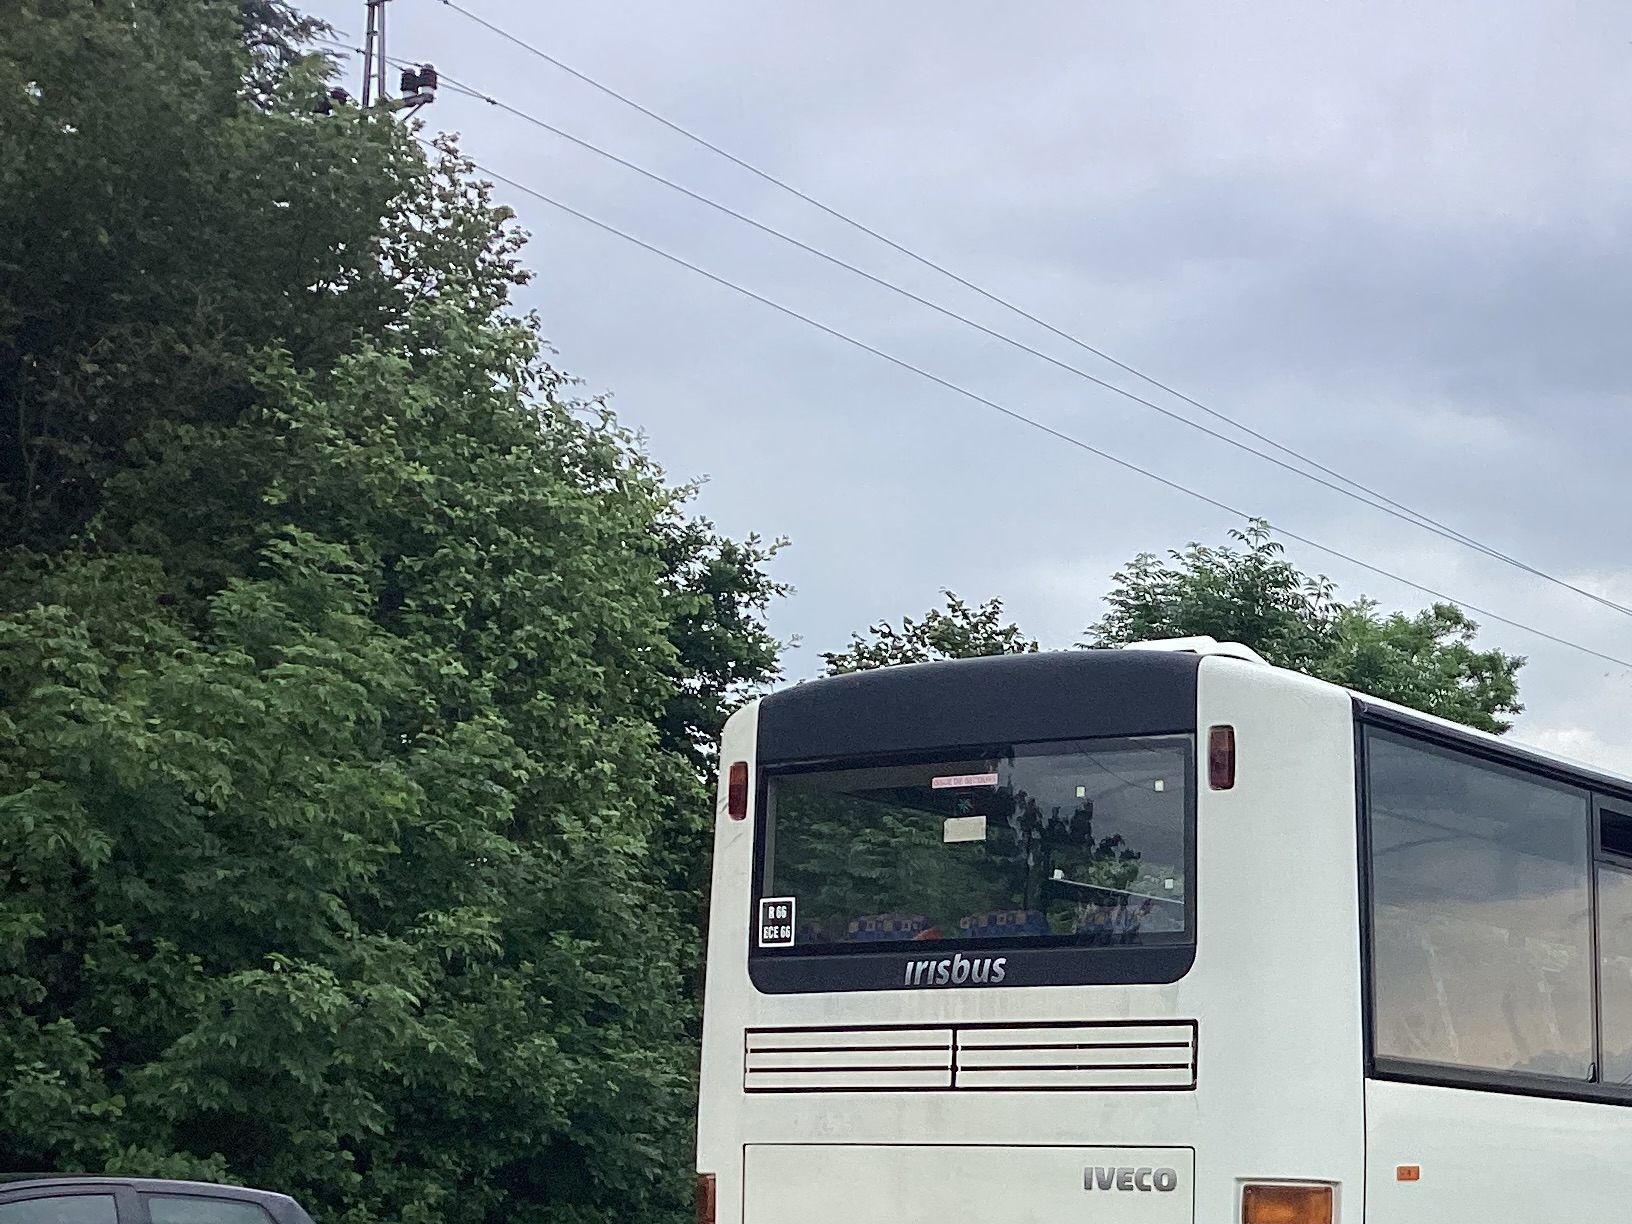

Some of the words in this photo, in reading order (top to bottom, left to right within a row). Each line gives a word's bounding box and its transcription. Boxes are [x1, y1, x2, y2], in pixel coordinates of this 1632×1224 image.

[768, 905, 775, 919] R
[776, 905, 787, 919] 66
[763, 926, 779, 939] ECE
[780, 925, 791, 938] 66
[1083, 1166, 1178, 1192] IVECO
